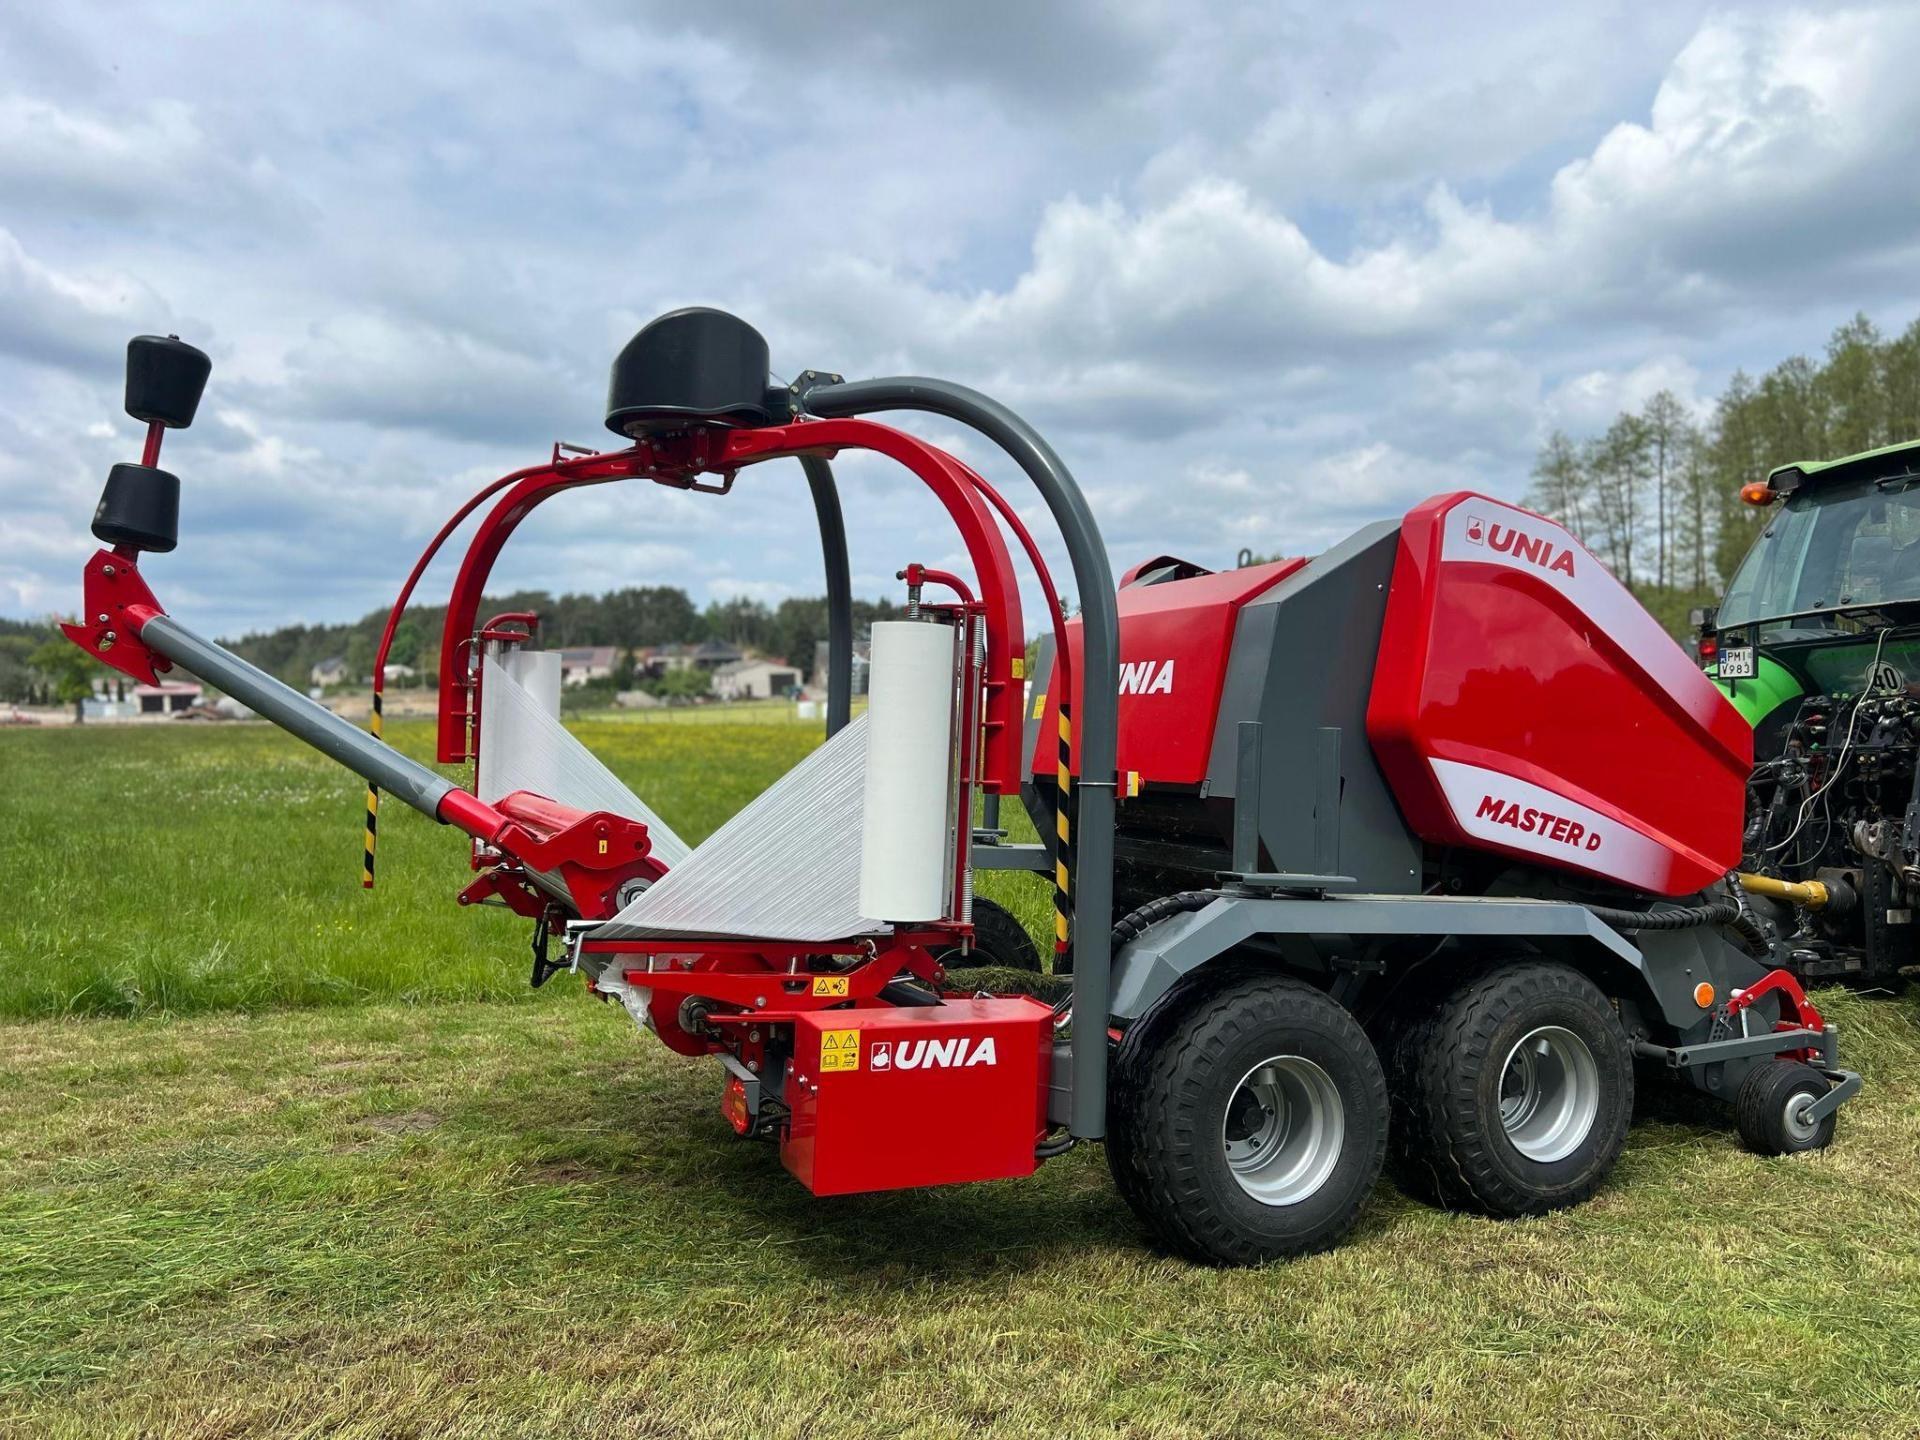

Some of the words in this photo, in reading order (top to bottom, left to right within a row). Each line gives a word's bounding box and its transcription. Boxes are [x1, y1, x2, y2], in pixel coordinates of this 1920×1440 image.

[1488, 523, 1575, 578] UNIA
[1722, 663, 1750, 675] V983
[1727, 651, 1746, 661] PMI
[1119, 660, 1174, 695] NIA
[1475, 795, 1585, 847] MASTER
[1585, 832, 1602, 851] D
[894, 1037, 997, 1070] UNIA
